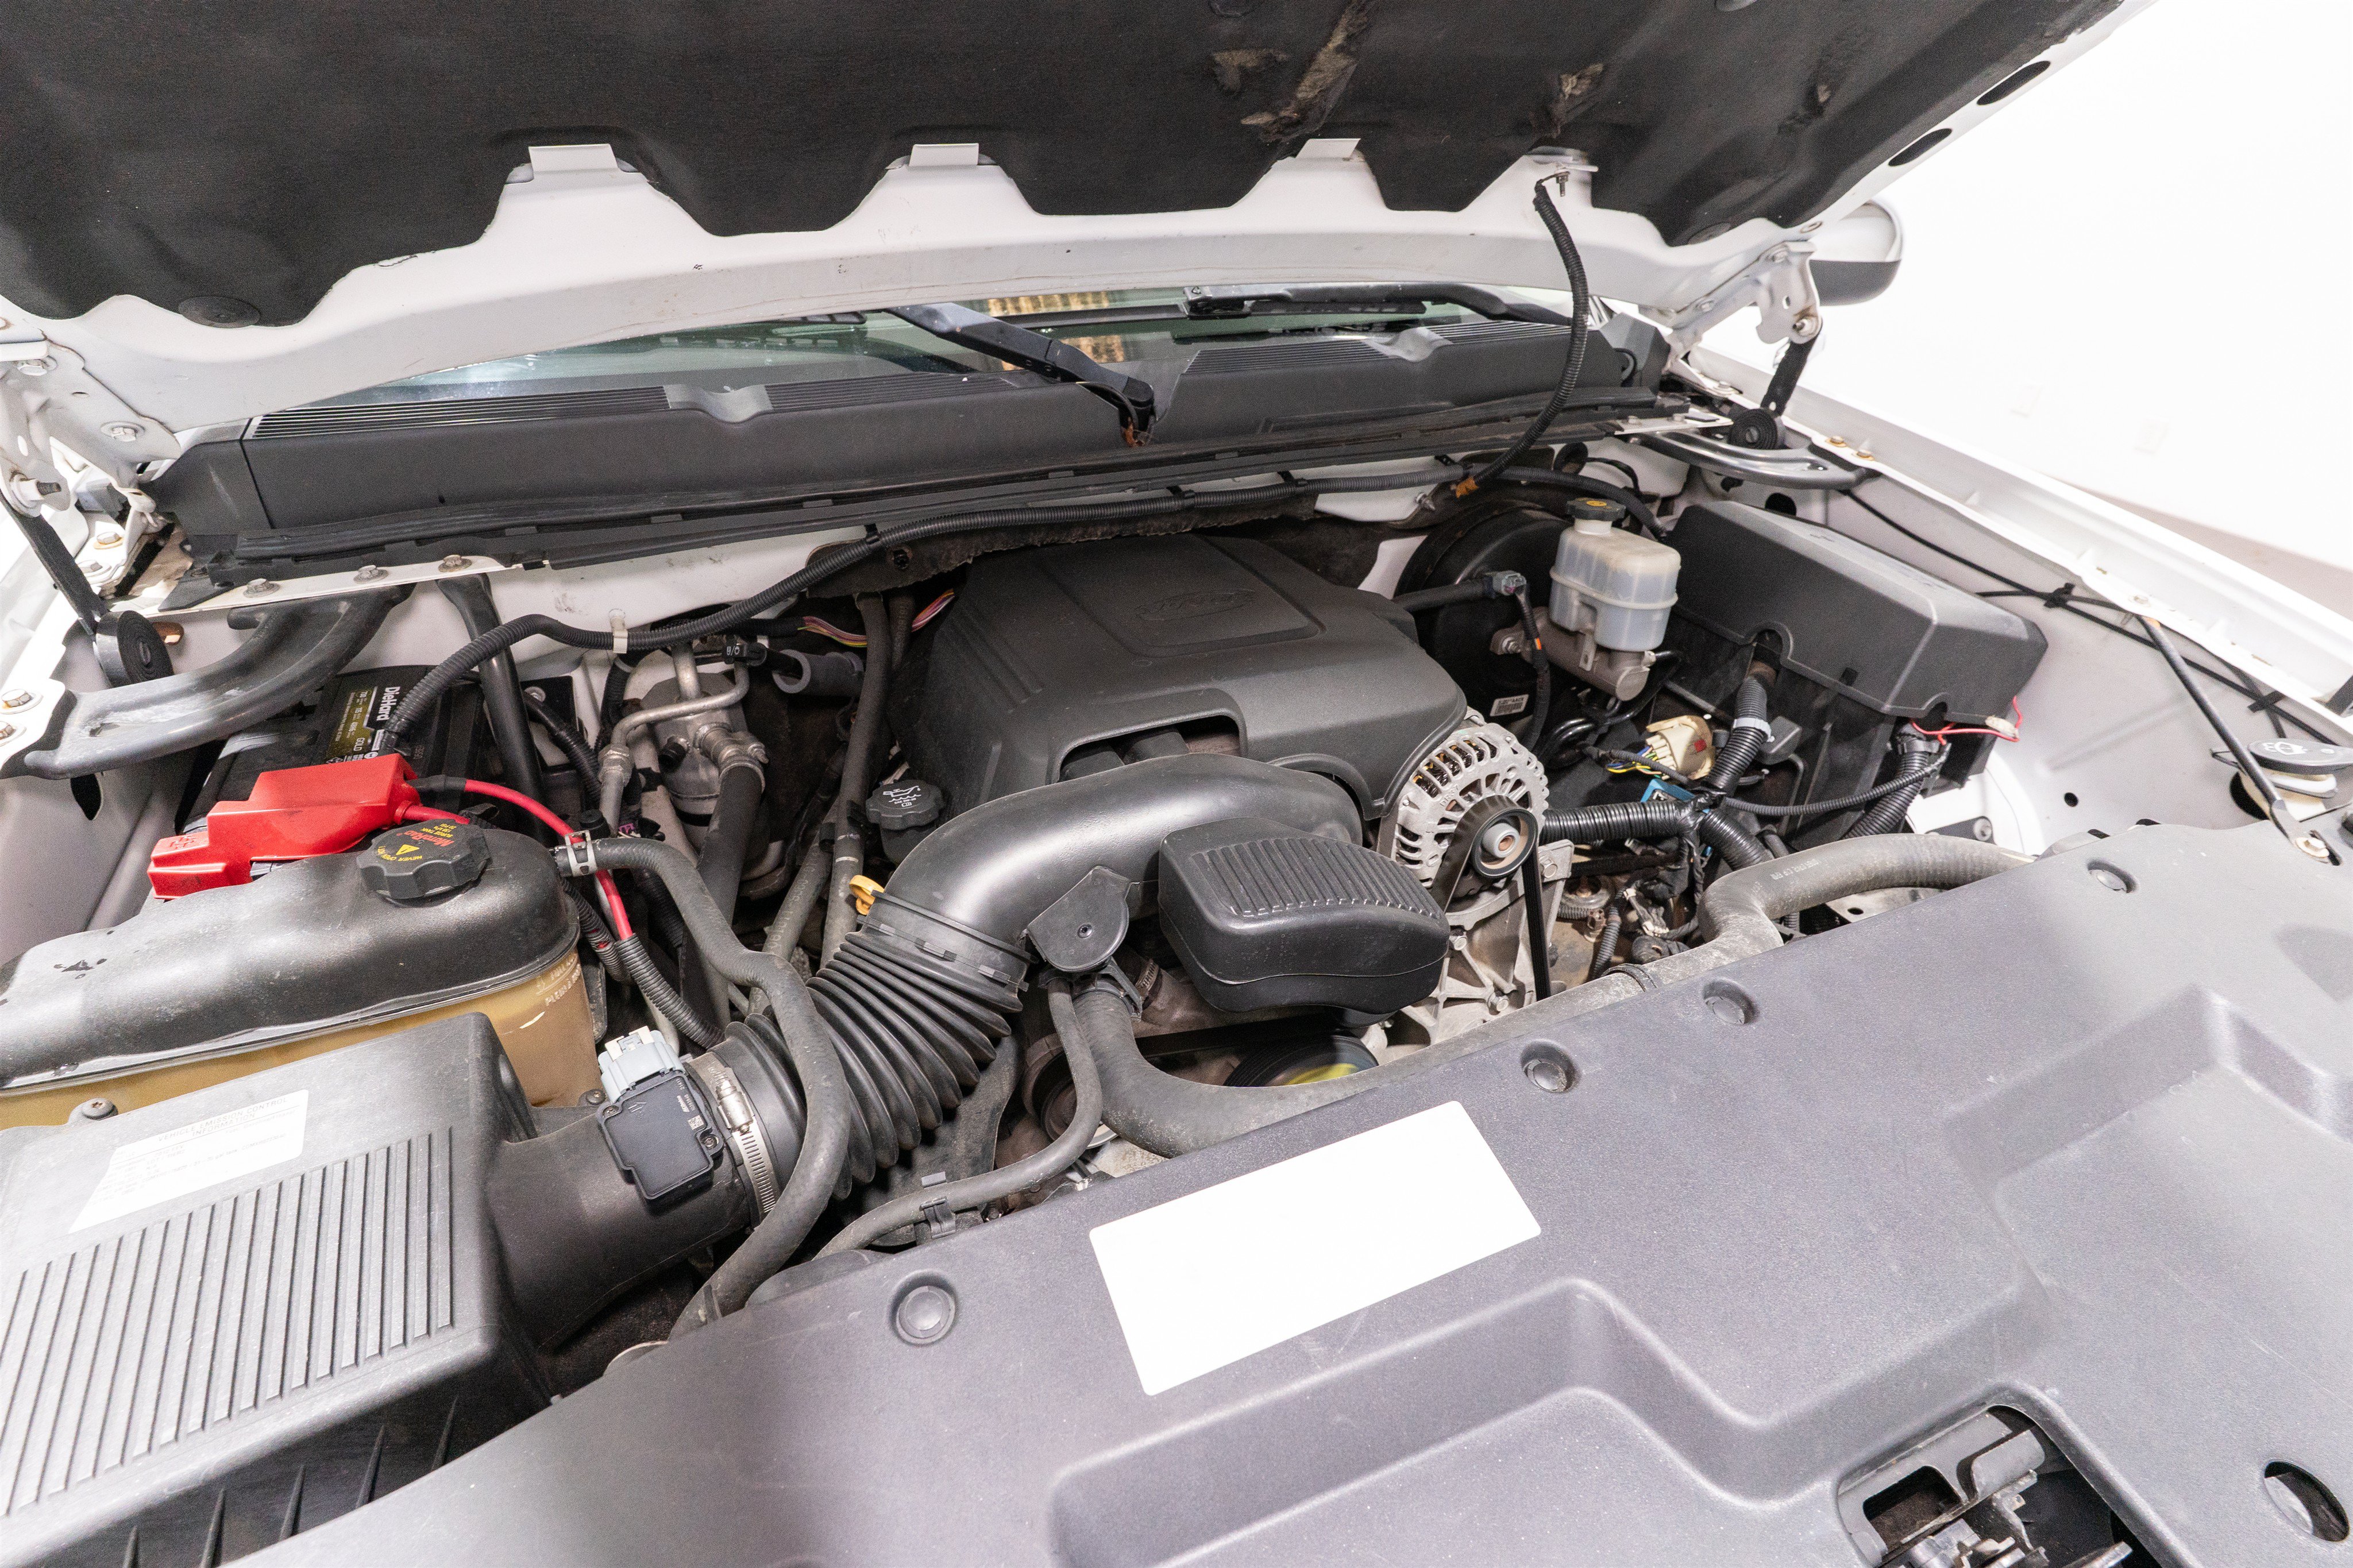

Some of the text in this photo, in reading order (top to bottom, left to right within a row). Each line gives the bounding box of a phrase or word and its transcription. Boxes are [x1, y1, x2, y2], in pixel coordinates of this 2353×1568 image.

[376, 686, 401, 721] DieHard
[353, 737, 365, 751] GOLD
[158, 1098, 288, 1142] VEHICLE EMISSION CONTROL
[192, 1113, 256, 1137] INFORMATION
